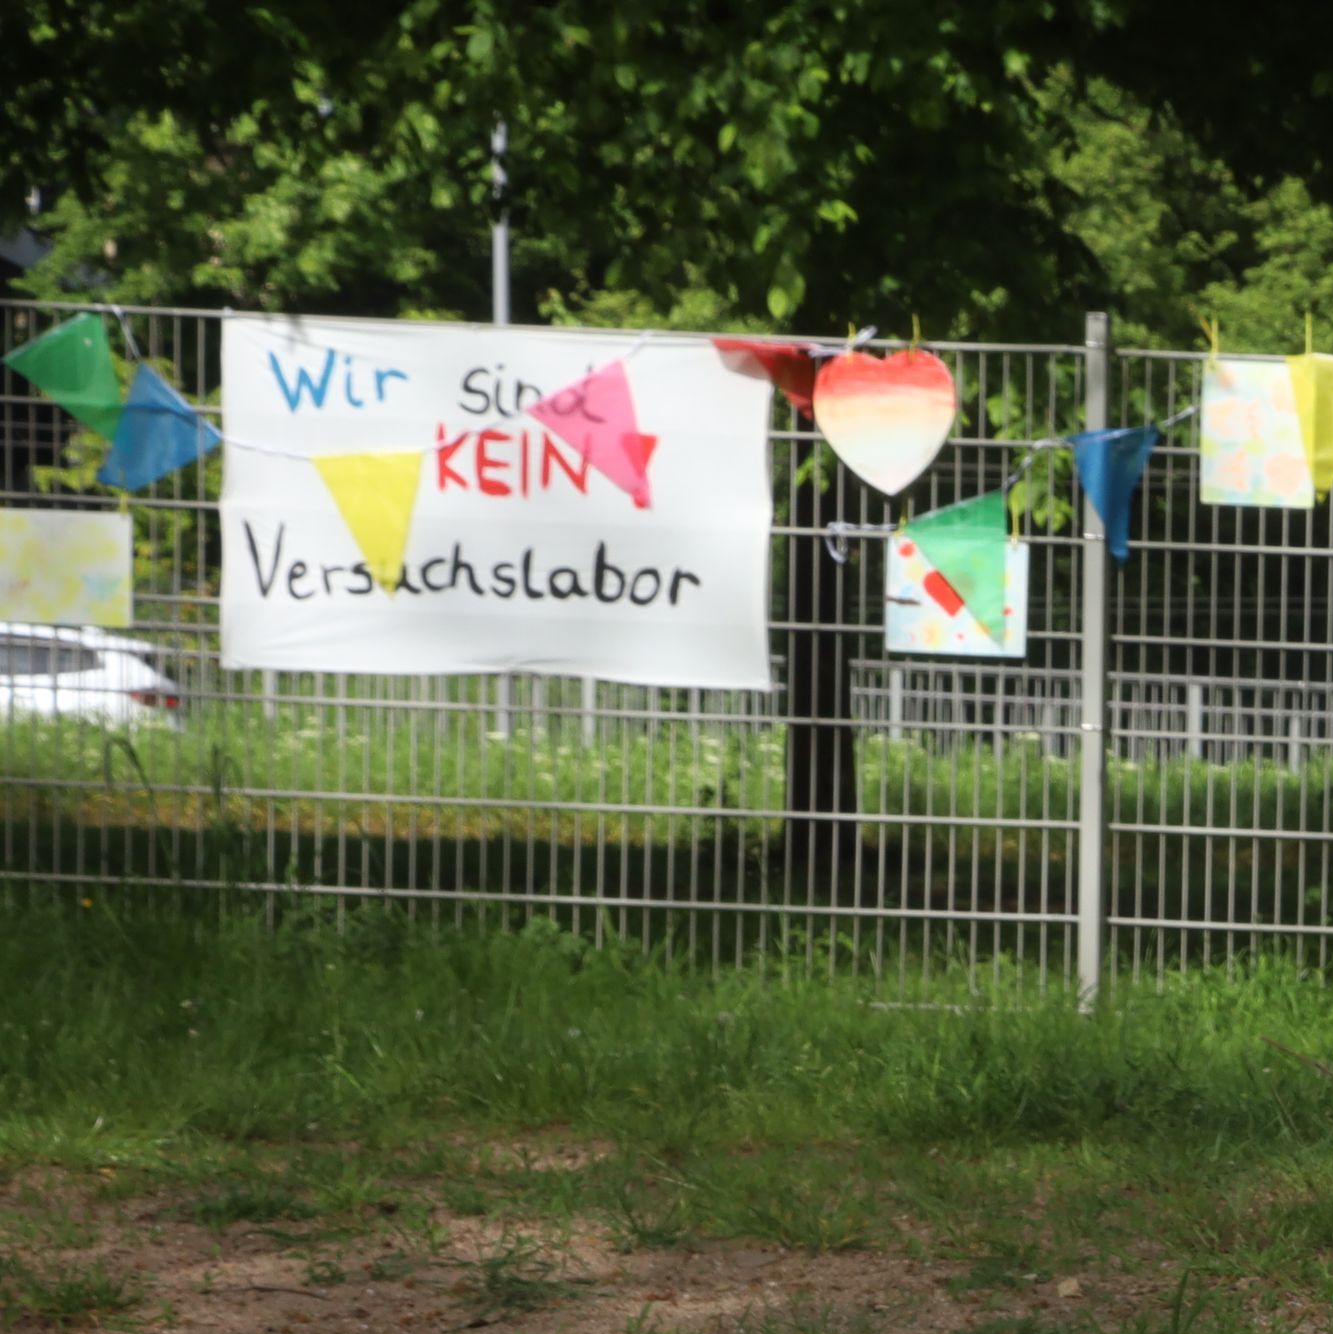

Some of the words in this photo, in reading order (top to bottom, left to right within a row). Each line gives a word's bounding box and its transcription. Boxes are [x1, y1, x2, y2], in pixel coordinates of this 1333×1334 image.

[268, 347, 409, 413] Wir
[436, 423, 593, 497] KEIN
[244, 519, 703, 607] Versuchslabor
